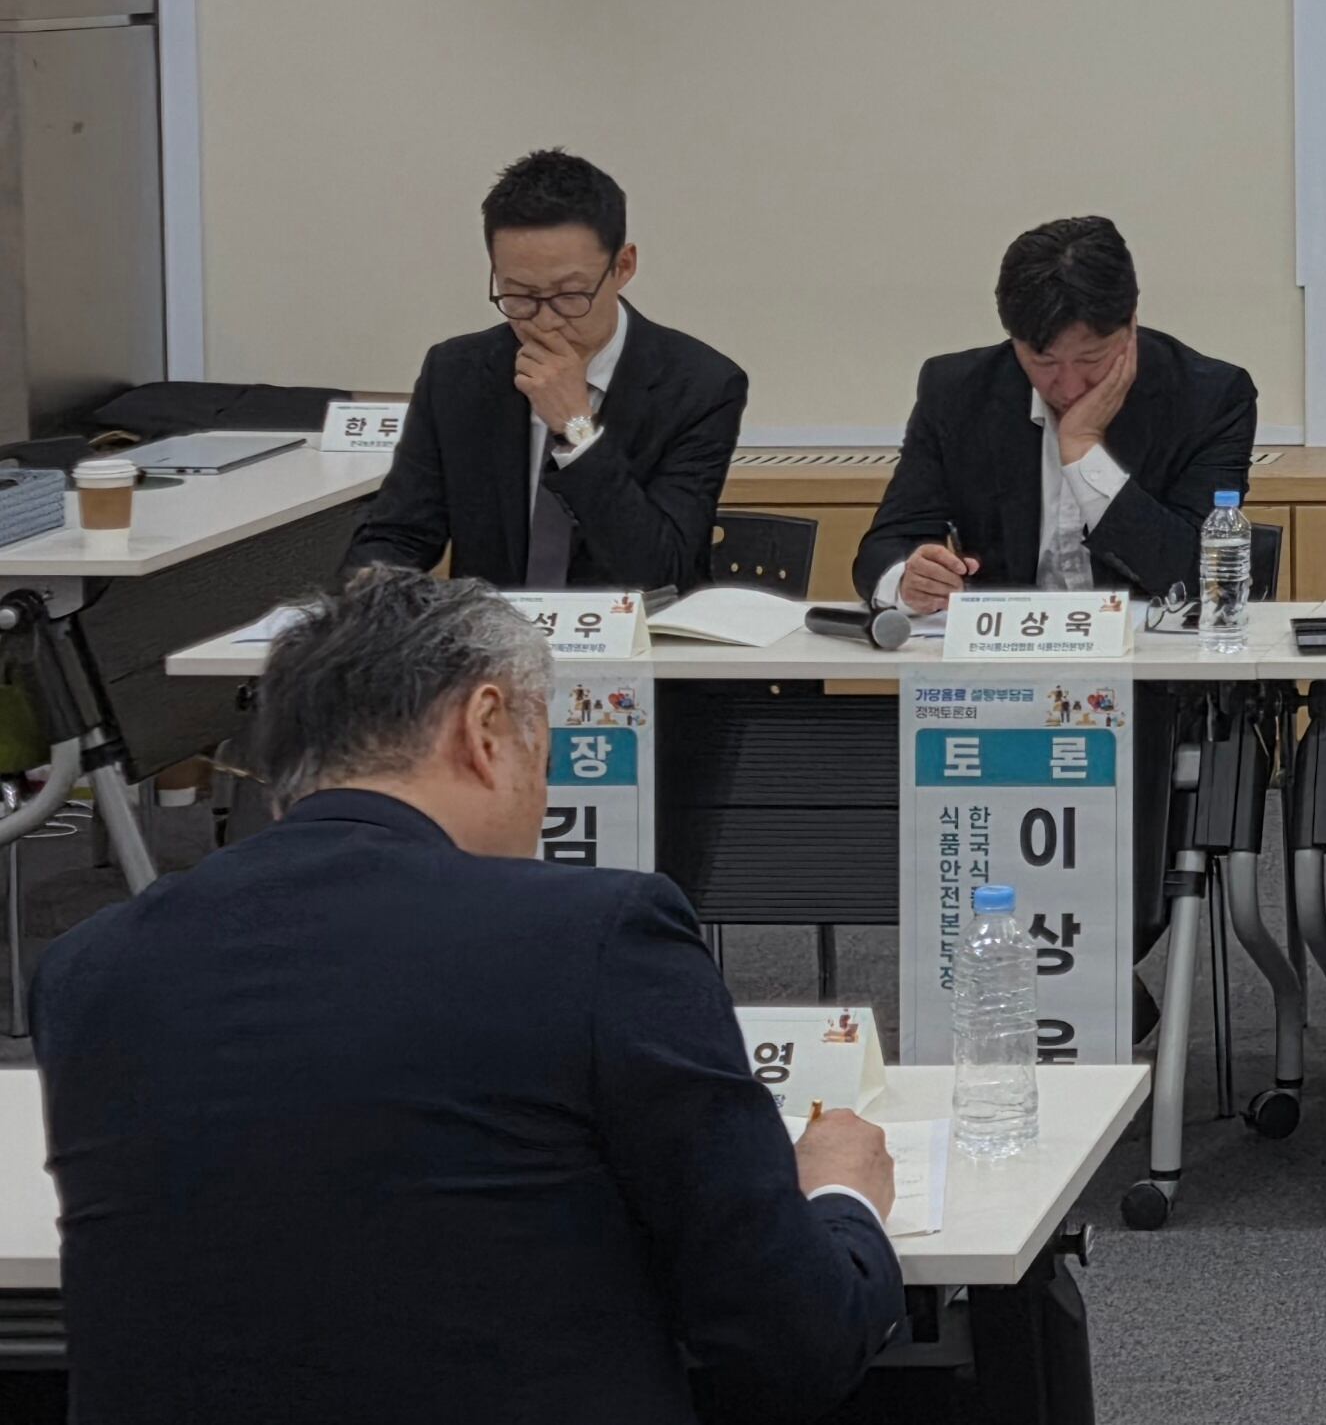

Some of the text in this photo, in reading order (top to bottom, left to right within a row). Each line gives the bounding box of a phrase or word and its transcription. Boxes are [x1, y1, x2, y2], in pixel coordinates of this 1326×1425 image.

[915, 688, 1035, 702] 가당음료 설탕부담금
[915, 705, 977, 720] 정책토론회
[570, 735, 612, 778] 장
[753, 1042, 794, 1083] 영
